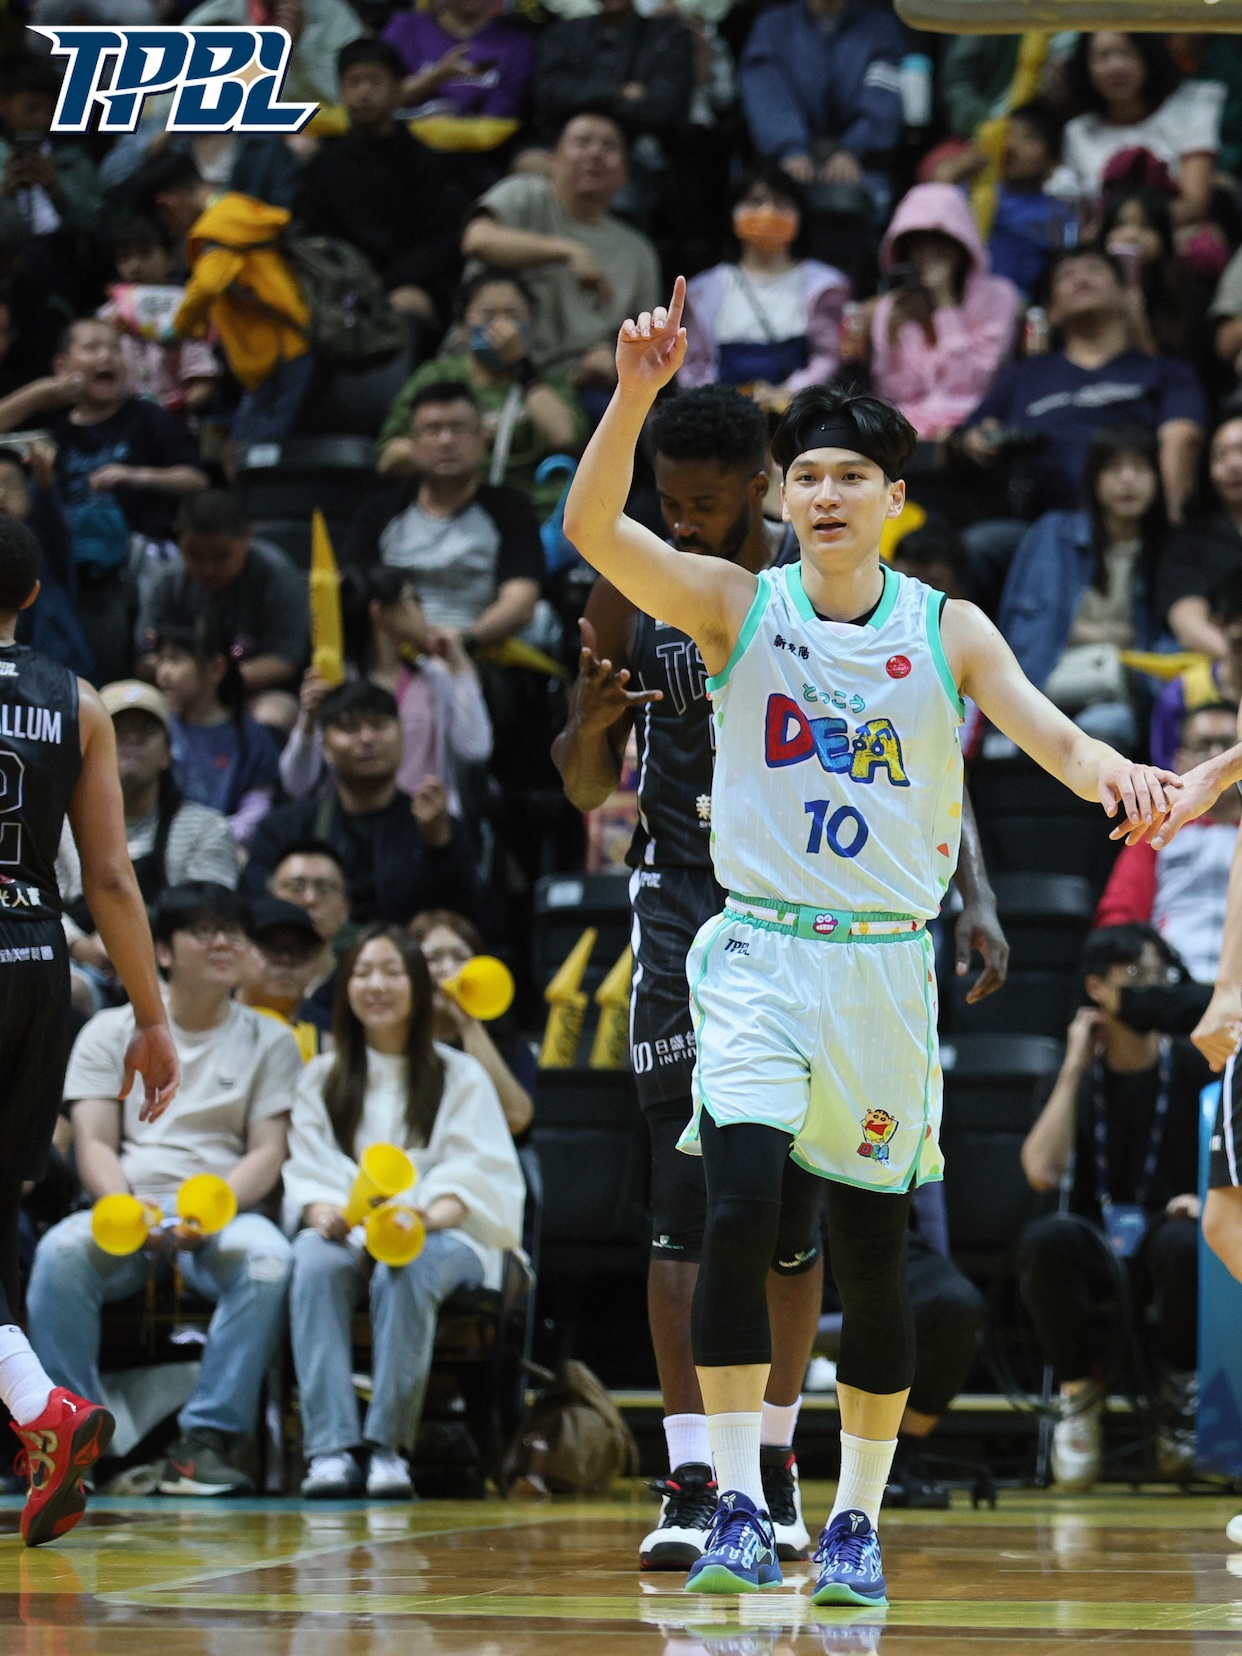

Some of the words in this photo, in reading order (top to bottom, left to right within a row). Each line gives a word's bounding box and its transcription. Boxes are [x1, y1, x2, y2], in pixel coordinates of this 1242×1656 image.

[802, 683, 866, 714] とっこう
[0, 703, 61, 744] LLUM
[765, 692, 911, 788] DEA
[804, 799, 869, 858] 10
[724, 938, 751, 956] TPBL
